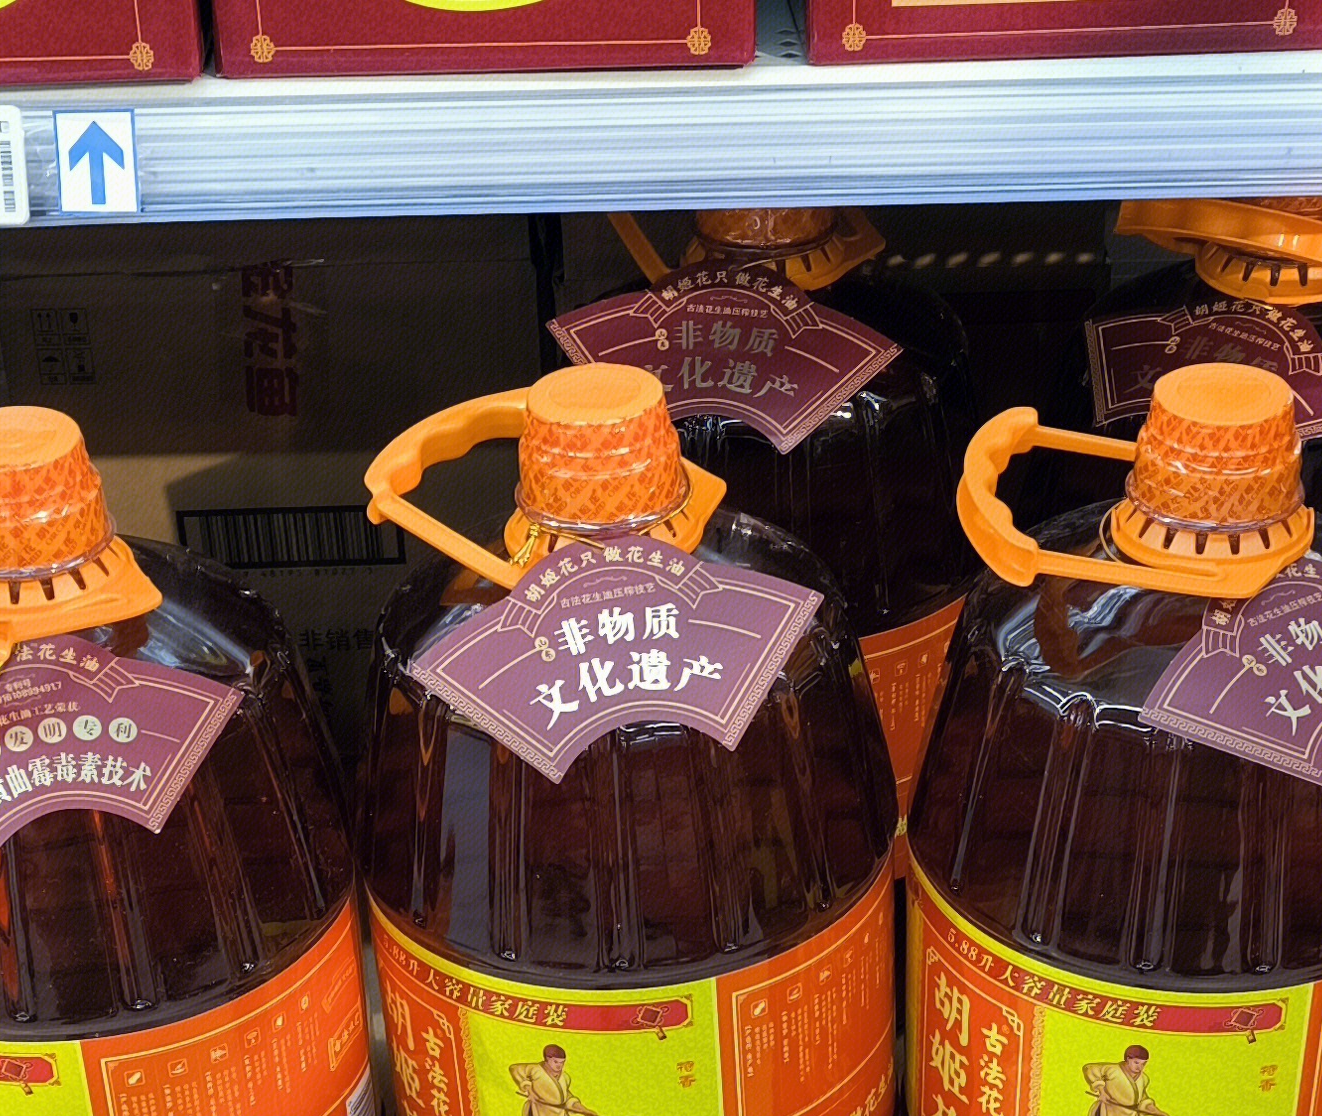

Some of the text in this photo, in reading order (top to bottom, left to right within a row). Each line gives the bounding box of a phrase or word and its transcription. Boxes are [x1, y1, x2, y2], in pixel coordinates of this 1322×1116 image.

[672, 320, 781, 358] 非物质
[524, 544, 686, 603] 胡姬花只做花生油
[553, 602, 682, 657] 非物质
[529, 648, 725, 732] 文化遗产
